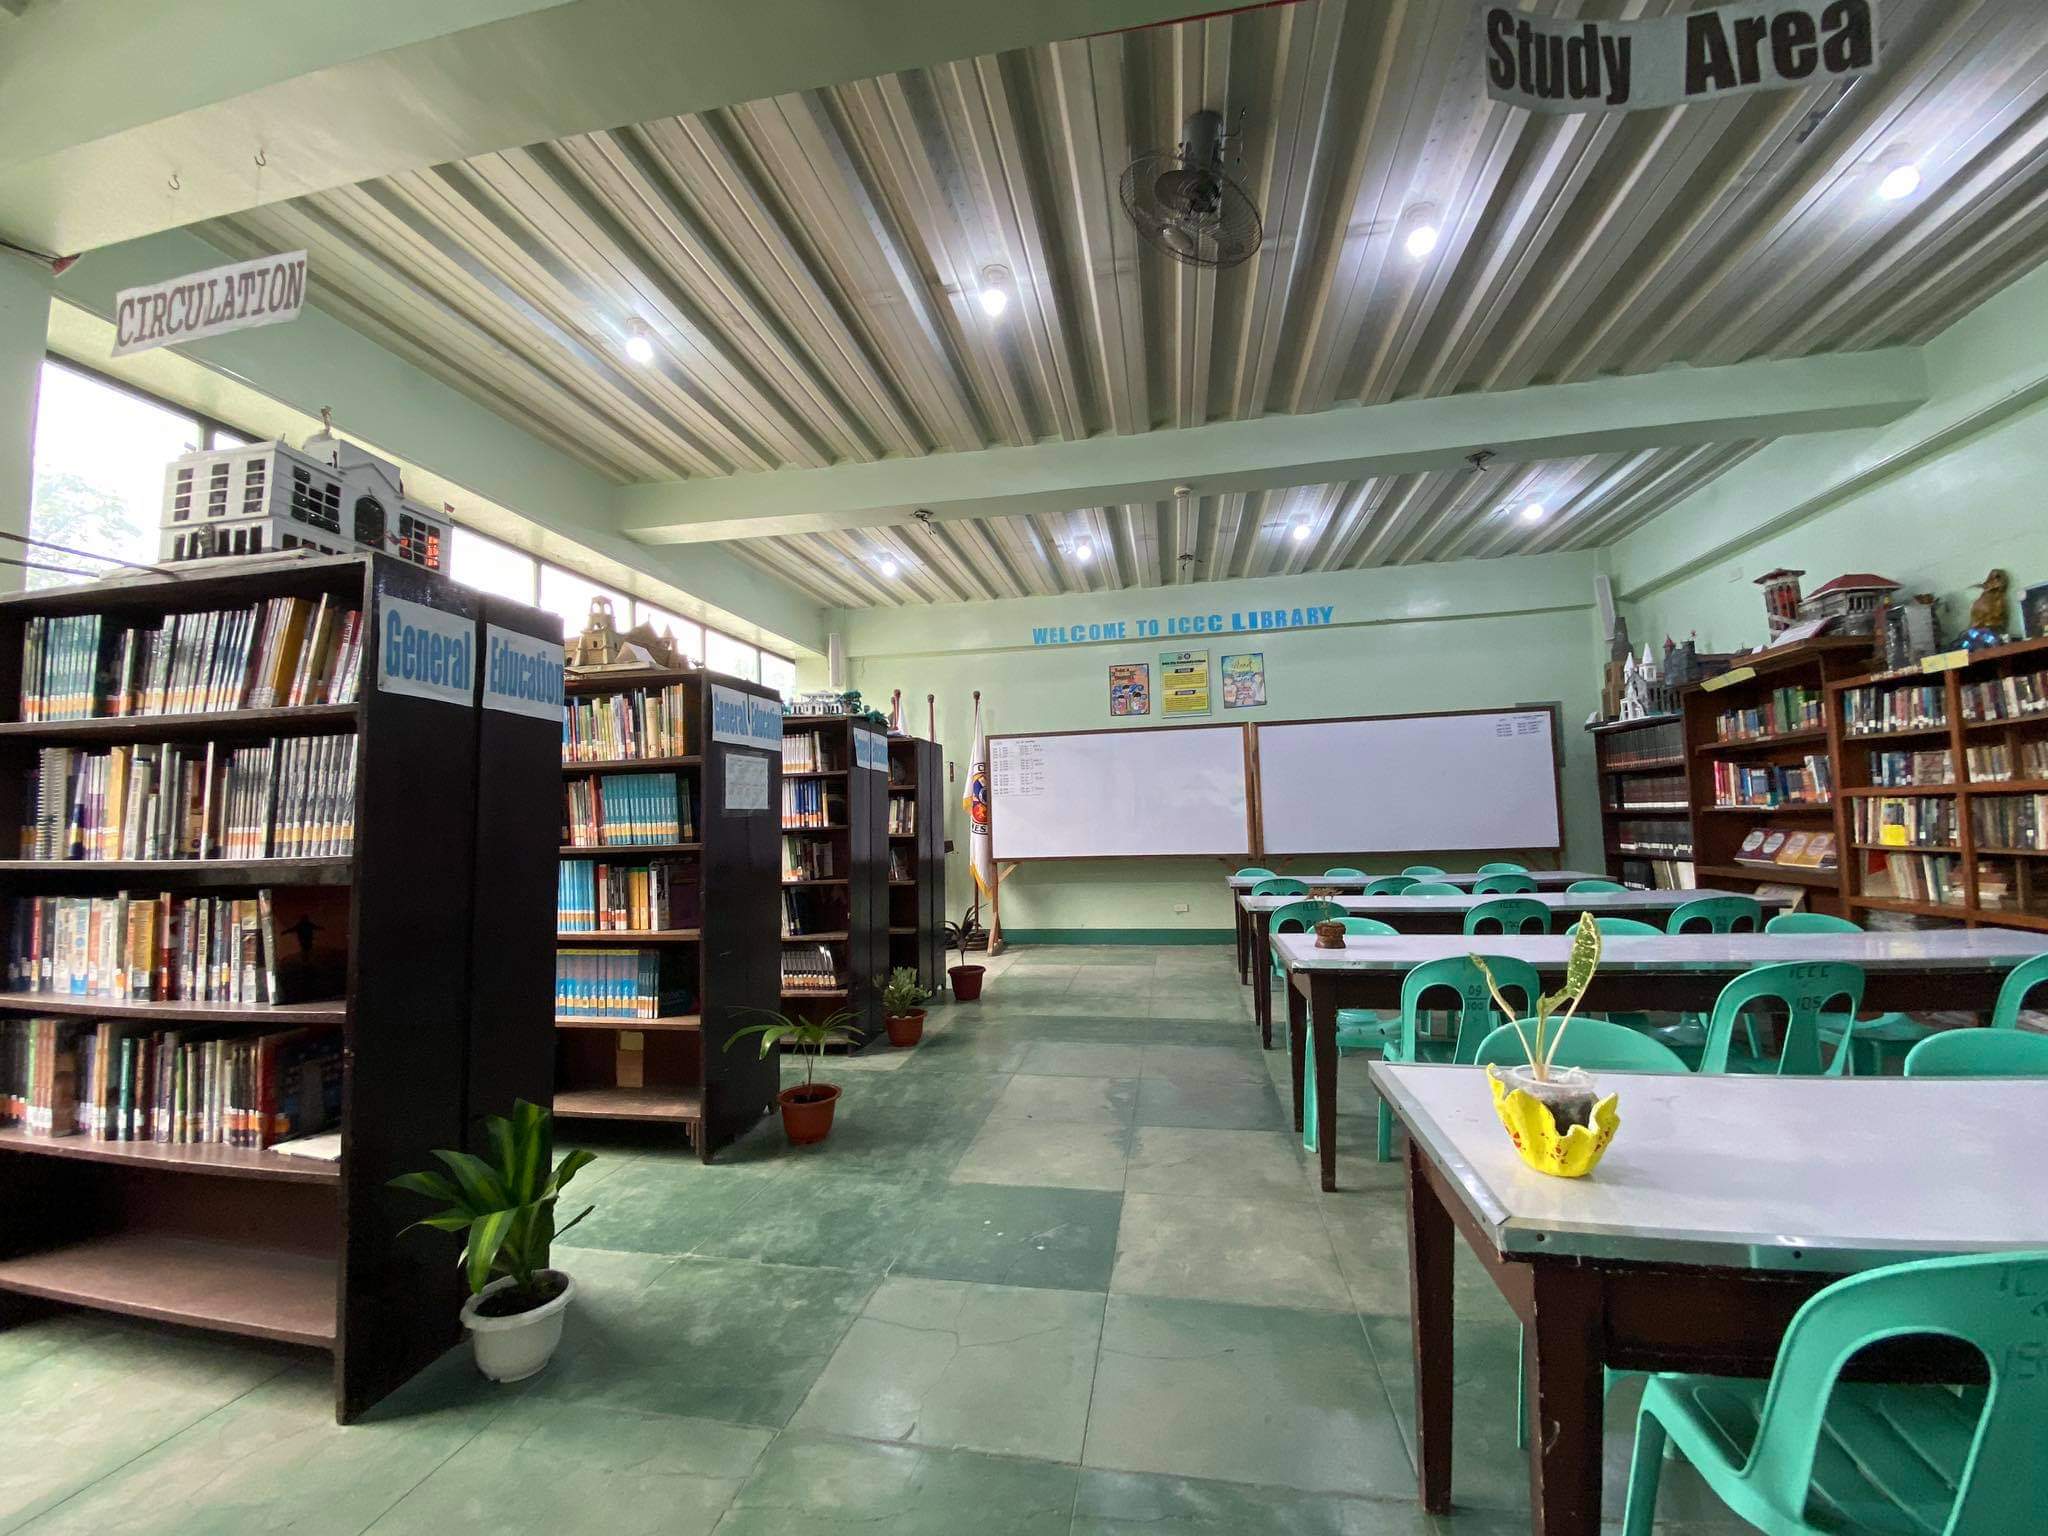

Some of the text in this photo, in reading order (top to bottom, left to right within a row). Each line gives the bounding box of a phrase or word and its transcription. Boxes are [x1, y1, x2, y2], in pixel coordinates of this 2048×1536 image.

[1487, 0, 1872, 105] Study Area
[116, 260, 305, 347] CIRCULATION
[385, 608, 471, 690] General
[489, 634, 564, 706] Education
[1032, 605, 1334, 646] WELCOME TO ICCC LIBRARY
